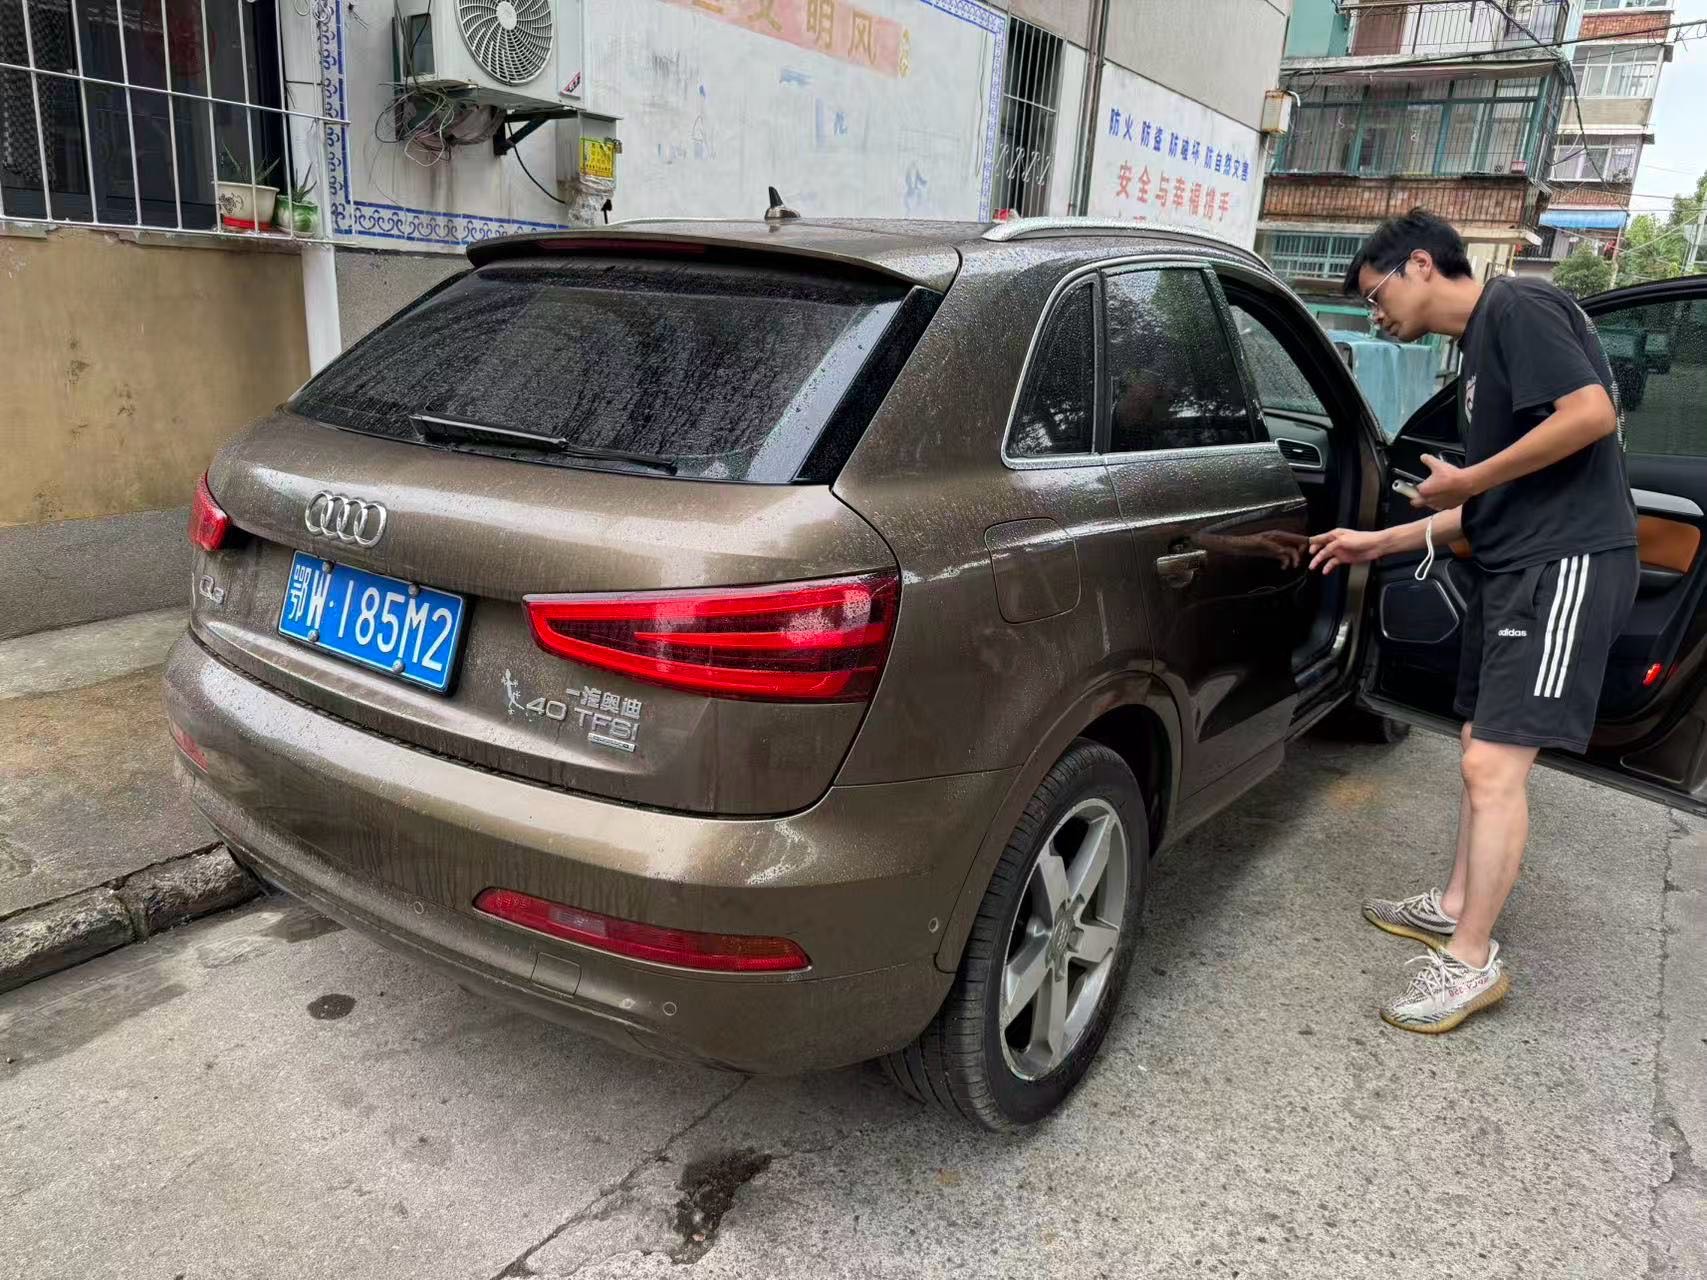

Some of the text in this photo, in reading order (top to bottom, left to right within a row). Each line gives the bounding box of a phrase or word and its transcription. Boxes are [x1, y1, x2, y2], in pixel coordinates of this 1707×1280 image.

[691, 0, 876, 65] 文明风
[1109, 108, 1134, 142] 防火
[1139, 120, 1164, 153] 防盗
[1204, 146, 1250, 182] 防自然灾害
[1116, 160, 1231, 222] 安全与幸福携手
[200, 575, 225, 604] Q3
[288, 563, 453, 672] 鄂W·185M2
[1498, 628, 1527, 637] adidas
[526, 697, 640, 742] 40 TFSI
[565, 686, 642, 720] 一汽奥迪
